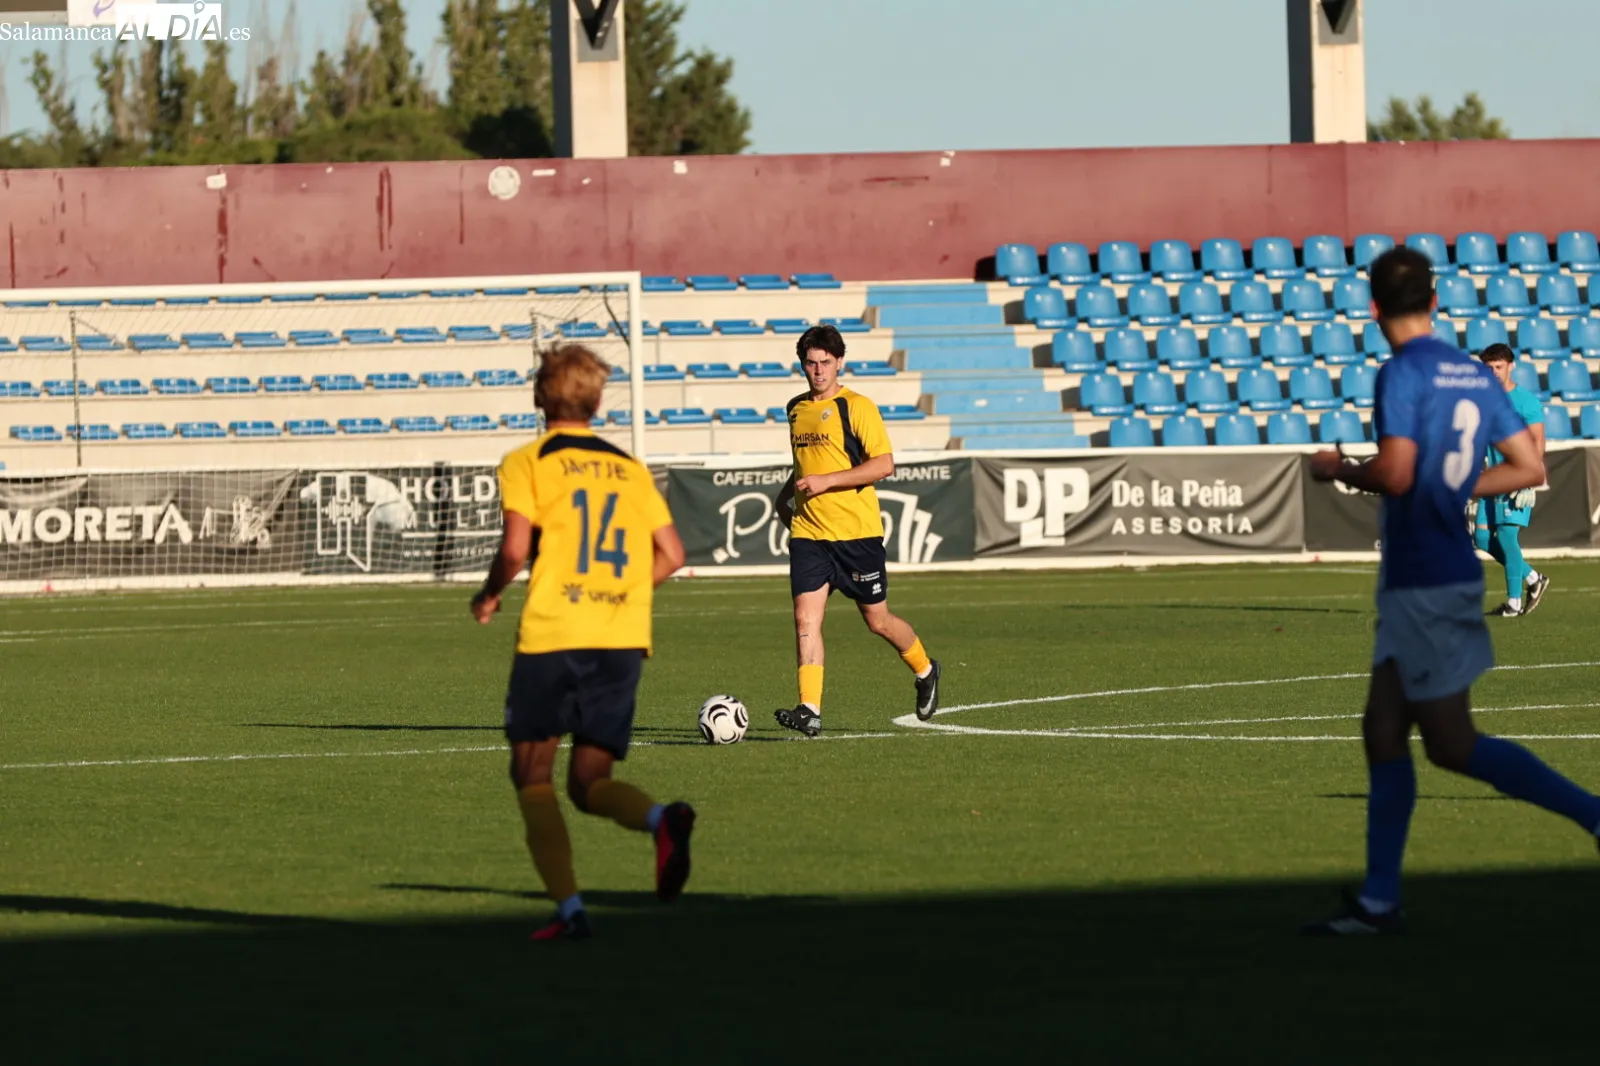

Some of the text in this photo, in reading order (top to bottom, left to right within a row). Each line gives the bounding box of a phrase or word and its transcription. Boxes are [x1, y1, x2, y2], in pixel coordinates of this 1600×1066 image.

[795, 432, 829, 442] MIRSAN
[1442, 398, 1480, 491] 3
[880, 465, 952, 482] URANTE
[400, 475, 503, 503] HOLD
[1111, 478, 1244, 507] De la Peña
[0, 503, 193, 544] MORETA
[572, 487, 629, 578] 14
[1111, 513, 1254, 535] ASESORÍA
